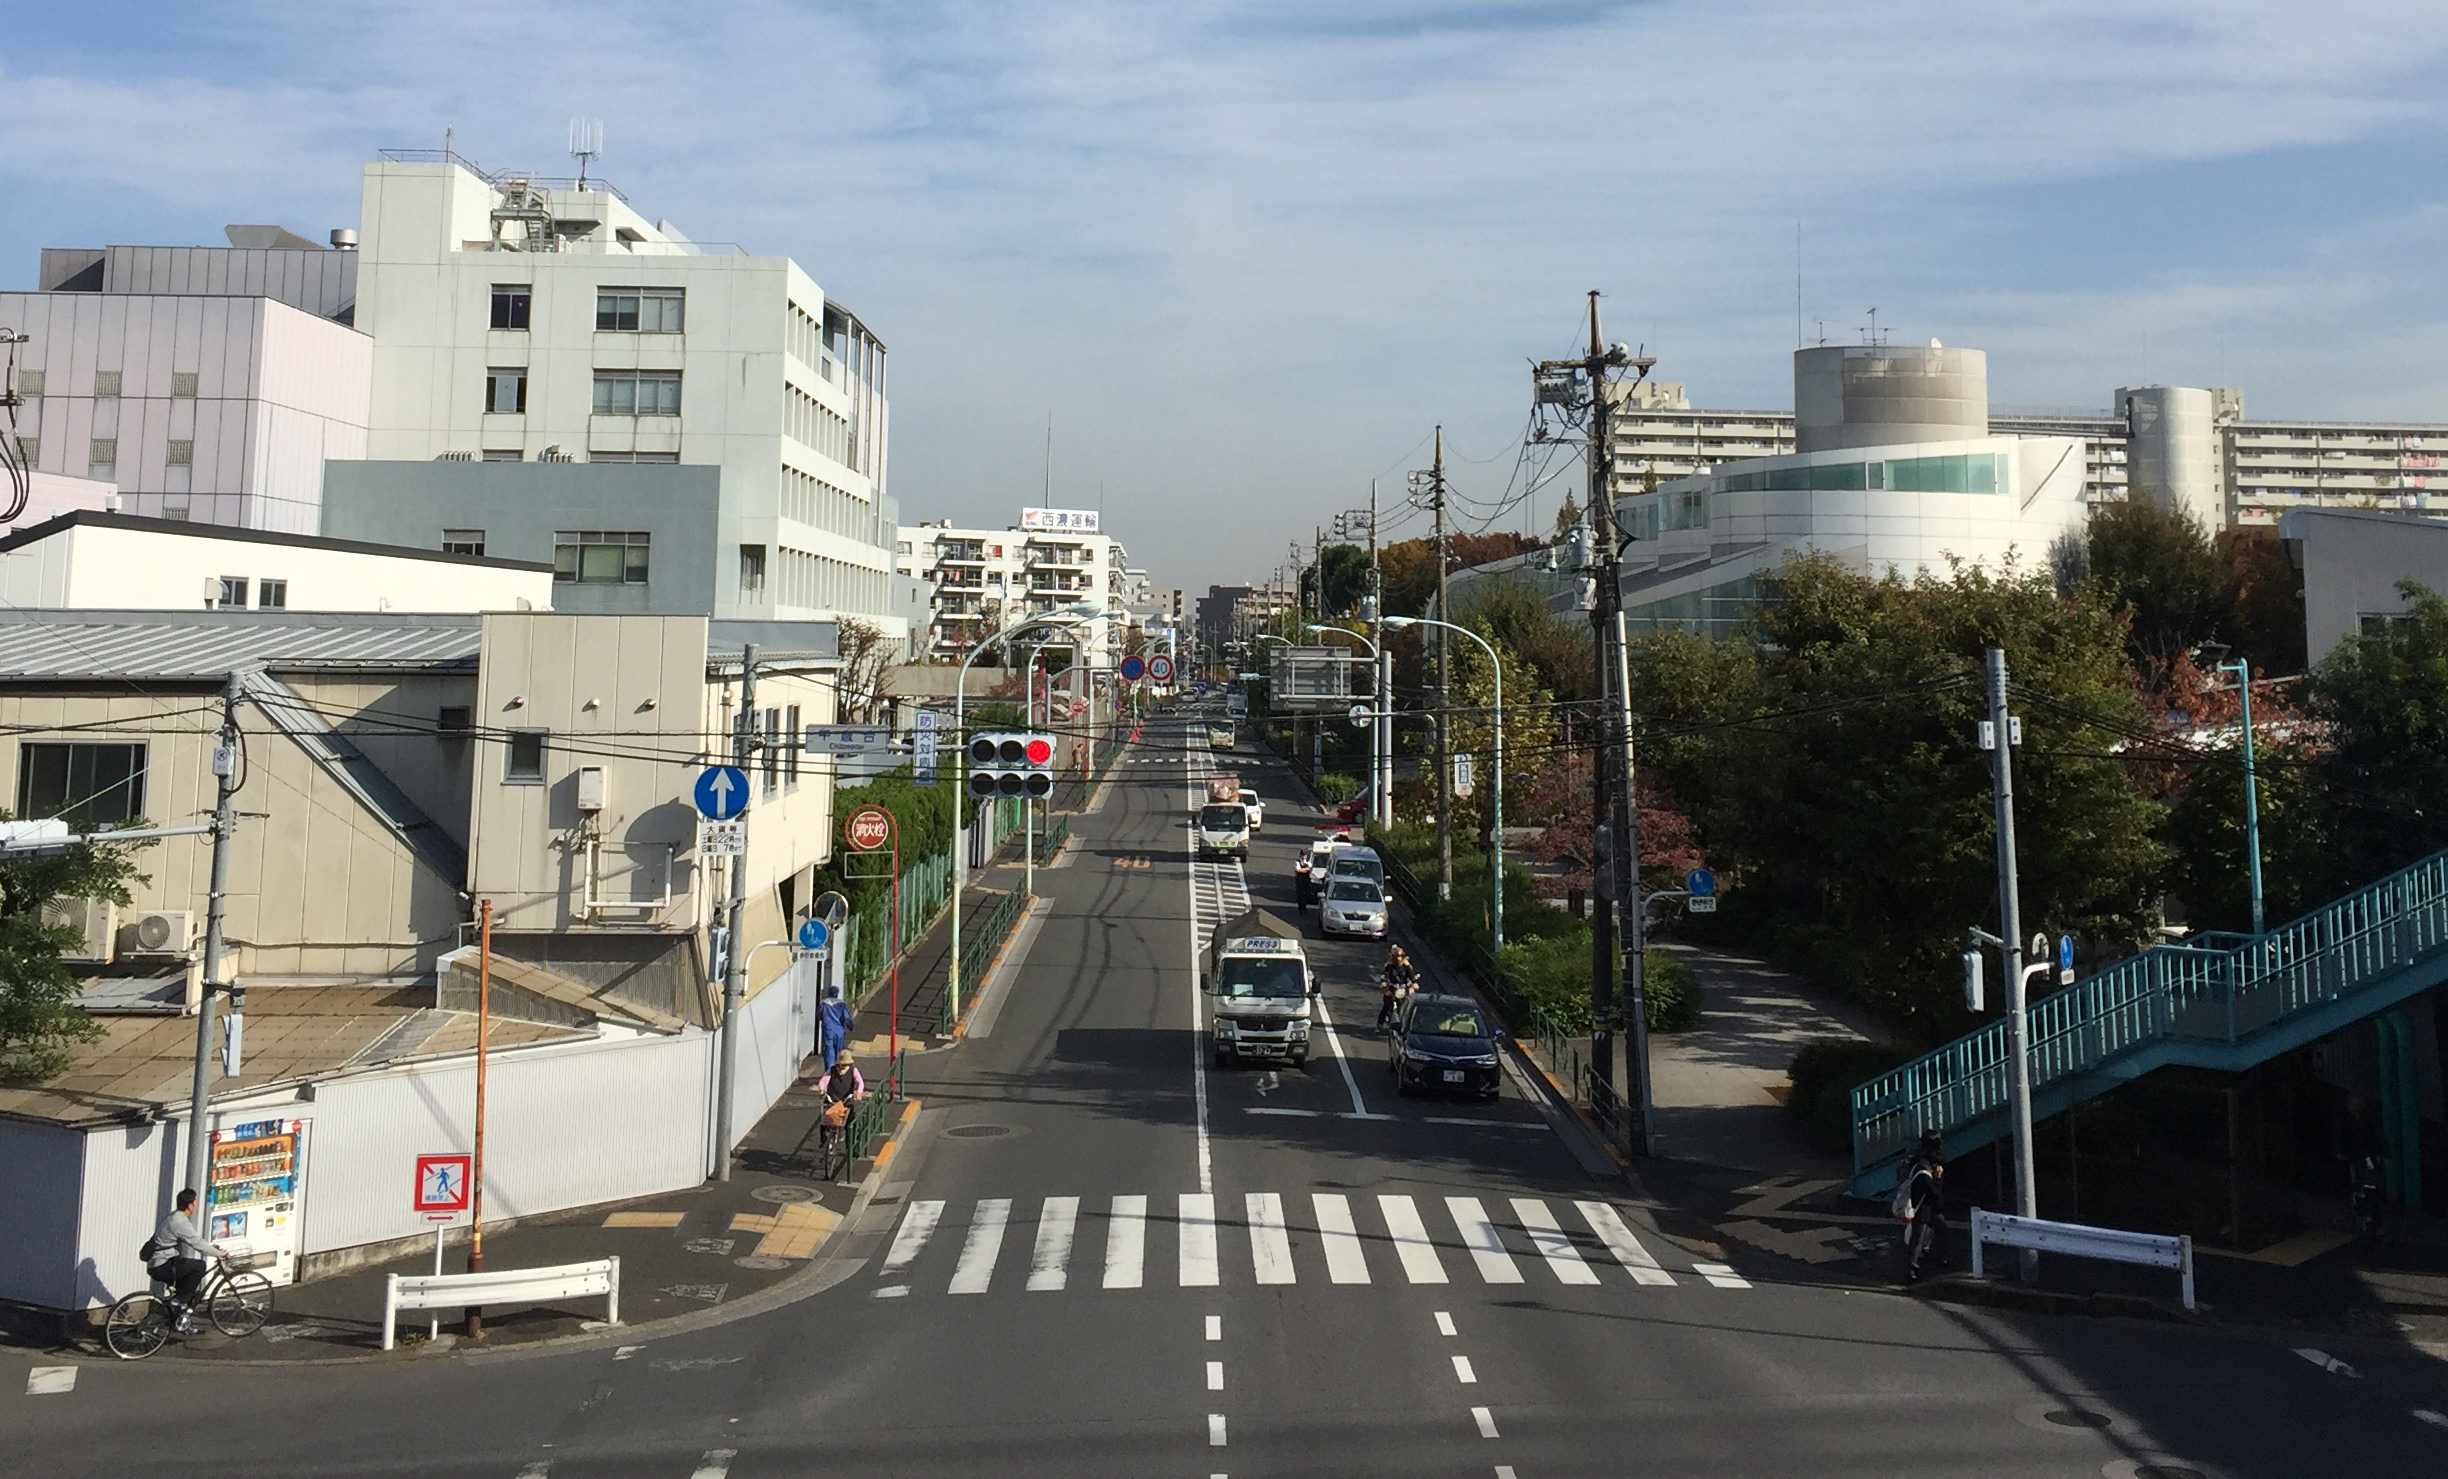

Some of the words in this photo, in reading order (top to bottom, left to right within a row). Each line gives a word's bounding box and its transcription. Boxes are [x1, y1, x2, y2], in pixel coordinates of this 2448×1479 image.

[1042, 512, 1097, 528] 西濃運輸
[1153, 662, 1168, 674] 40
[855, 822, 885, 837] 消火栓
[1246, 939, 1278, 949] PRESS
